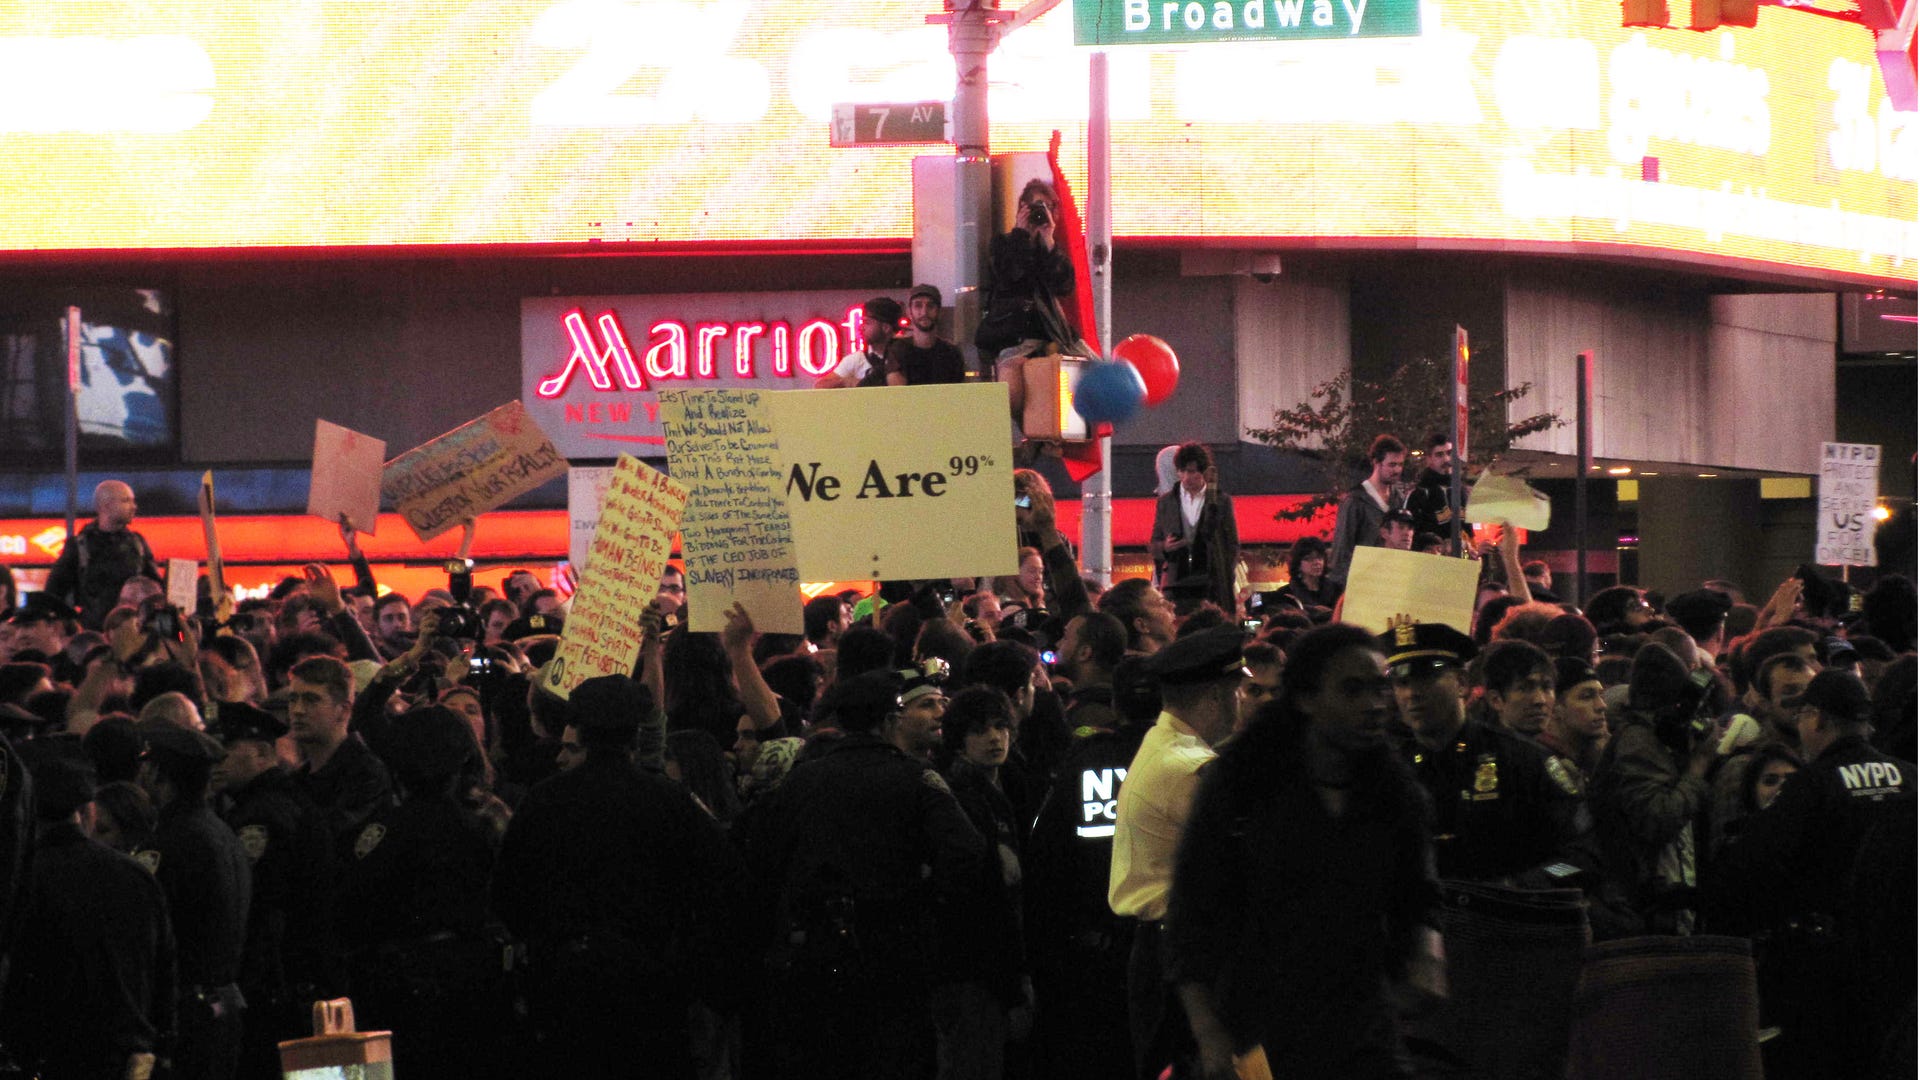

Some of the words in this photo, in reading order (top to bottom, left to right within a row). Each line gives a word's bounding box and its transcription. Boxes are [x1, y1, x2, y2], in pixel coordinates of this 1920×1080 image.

[1124, 0, 1368, 35] Broadway
[869, 107, 890, 139] 7
[910, 105, 933, 123] AV
[535, 307, 867, 398] Marriot
[565, 402, 632, 424] NEW
[704, 465, 714, 480] A
[786, 462, 841, 502] We
[856, 459, 947, 499] Are
[949, 455, 994, 477] 99%
[1832, 513, 1864, 532] US
[1827, 531, 1863, 546] FOR
[722, 550, 745, 564] CEO
[748, 548, 769, 562] JOB
[1838, 762, 1903, 789] NYPD
